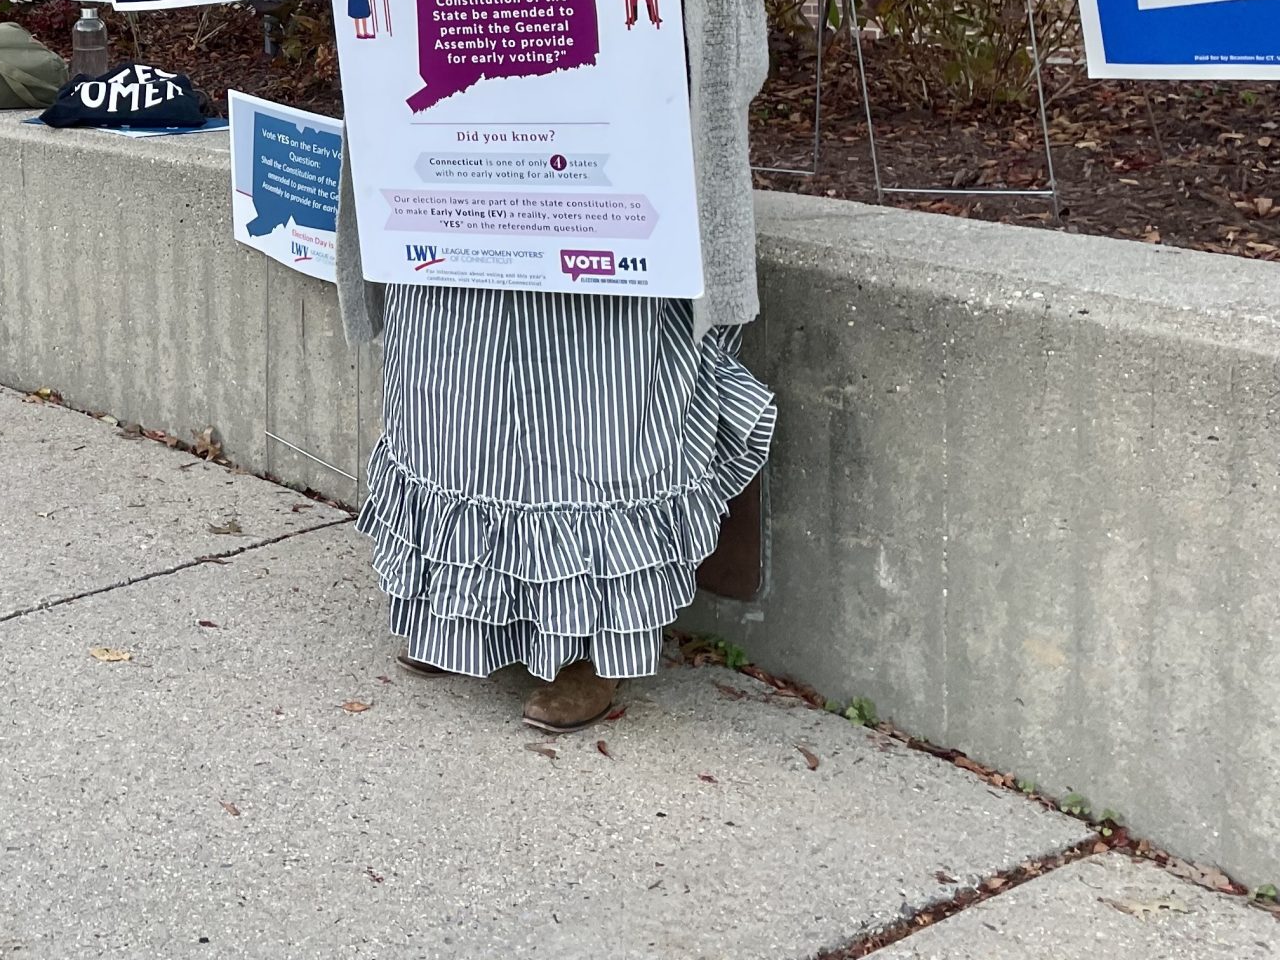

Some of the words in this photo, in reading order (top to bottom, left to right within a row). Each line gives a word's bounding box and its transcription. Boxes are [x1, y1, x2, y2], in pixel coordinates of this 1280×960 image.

[432, 10, 468, 21] State
[472, 9, 488, 20] be
[492, 5, 554, 19] amended
[559, 6, 574, 17] to
[440, 23, 484, 37] permit
[488, 22, 511, 34] the
[515, 20, 569, 33] General
[434, 37, 497, 50] Assembly
[501, 38, 516, 48] to
[521, 35, 574, 49] provide
[447, 53, 467, 64] for
[471, 51, 505, 65] early
[509, 50, 567, 63] voting?"
[70, 80, 184, 112] OMEN
[262, 128, 276, 140] Vote
[277, 133, 289, 144] YES
[300, 141, 311, 152] the
[313, 144, 331, 158] Early
[457, 131, 479, 142] Did
[483, 132, 507, 144] you
[512, 130, 556, 142] know?
[289, 151, 320, 168] Question:
[429, 158, 483, 166] Connecticut
[485, 158, 494, 166] is
[515, 159, 526, 167] of
[528, 159, 548, 168] only
[471, 170, 493, 179] early
[496, 170, 524, 180] voting
[527, 170, 540, 178] for
[544, 170, 555, 179] all
[431, 208, 453, 217] Early
[455, 209, 485, 218] Voting
[487, 210, 507, 219] (EV)
[481, 222, 495, 230] the
[498, 223, 551, 231] referendum
[292, 229, 313, 242] Election
[315, 237, 327, 247] Day
[292, 241, 309, 258] LWV
[405, 244, 438, 261] LWV
[441, 248, 470, 256] LEAGUE
[480, 249, 512, 257] WOMEN
[563, 255, 612, 270] VOTE
[618, 257, 647, 272] 411
